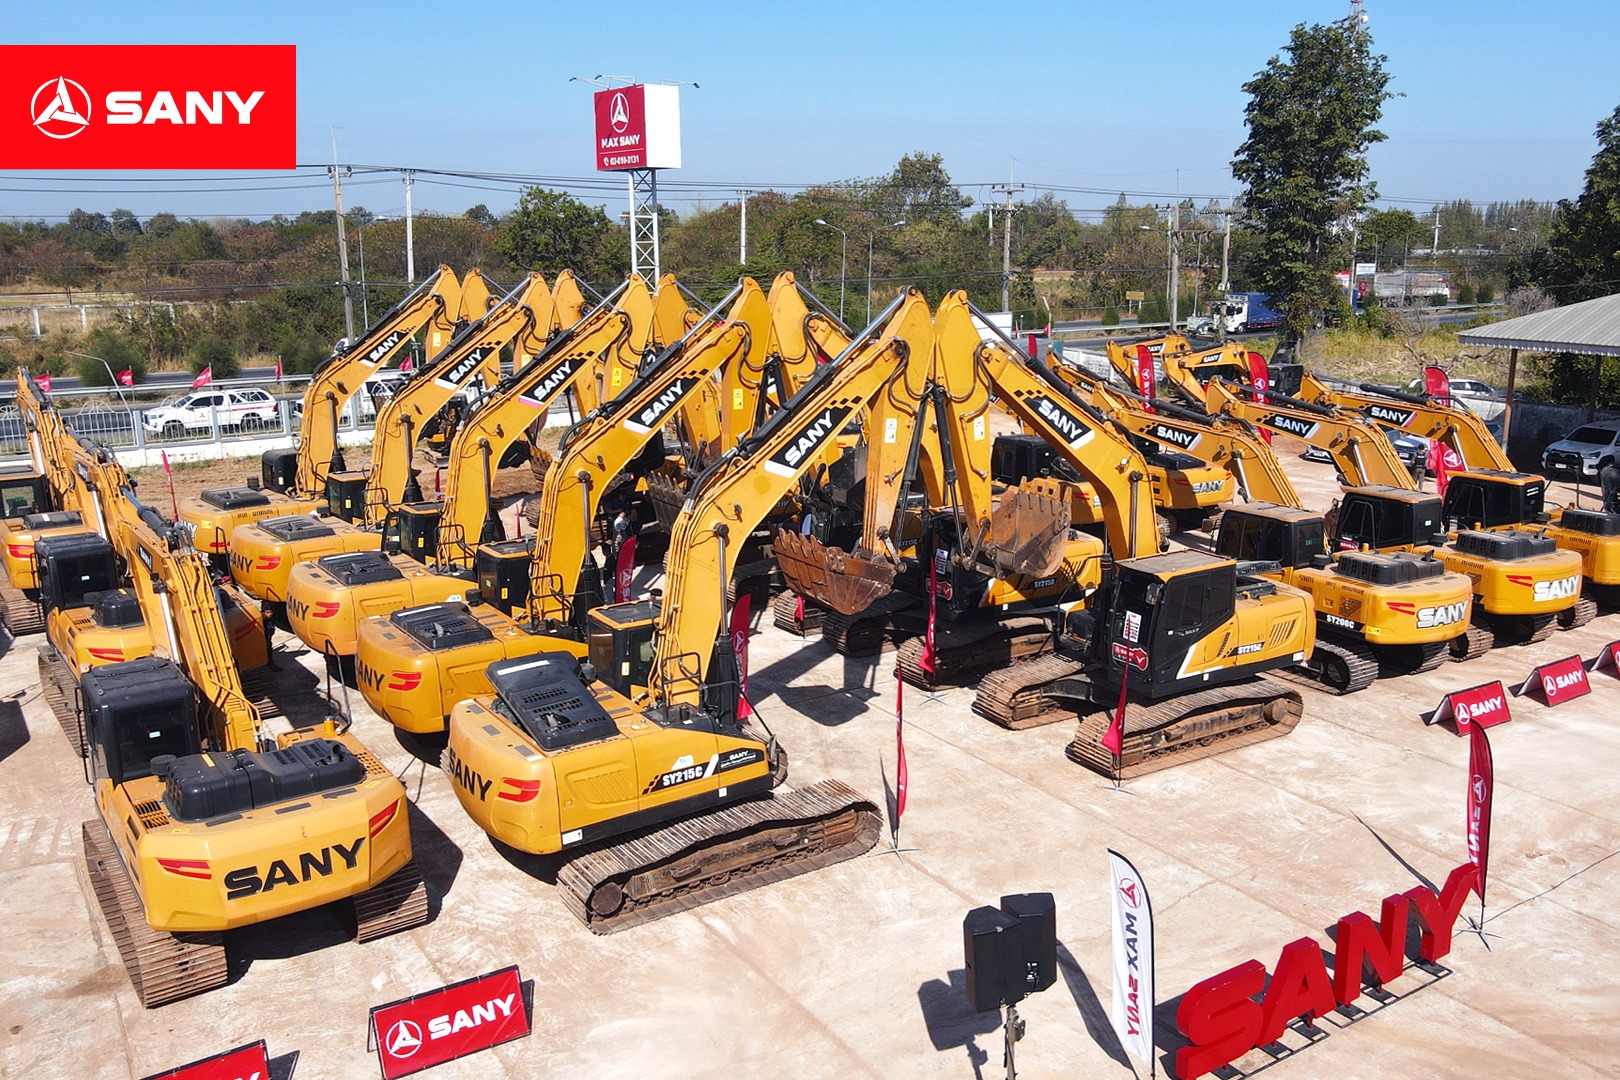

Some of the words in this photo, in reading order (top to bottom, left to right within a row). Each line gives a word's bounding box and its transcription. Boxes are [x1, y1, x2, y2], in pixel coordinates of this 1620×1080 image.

[601, 136, 619, 149] MAX
[620, 134, 640, 147] SANY
[369, 331, 400, 362] SANY
[1203, 353, 1220, 363] SANY
[449, 348, 482, 383] SANY
[533, 360, 574, 401] SANY
[640, 379, 684, 426] SANY
[1371, 406, 1407, 425] SANY
[1037, 398, 1083, 440] SANY
[1273, 416, 1310, 433] SANY
[784, 409, 833, 467] SANY
[1157, 425, 1193, 447] SANY
[1192, 480, 1225, 494] SANY
[1532, 574, 1580, 602] SANY
[1416, 599, 1469, 629] SANY
[1237, 642, 1262, 656] SY215C
[1555, 669, 1584, 689] SANY
[1470, 696, 1503, 718] SANY
[728, 750, 749, 761] SANY
[449, 747, 493, 803] SANY
[662, 765, 704, 787] SY215C
[224, 836, 367, 901] SANY
[1176, 861, 1479, 1080] SANY
[427, 992, 516, 1041] SANY
